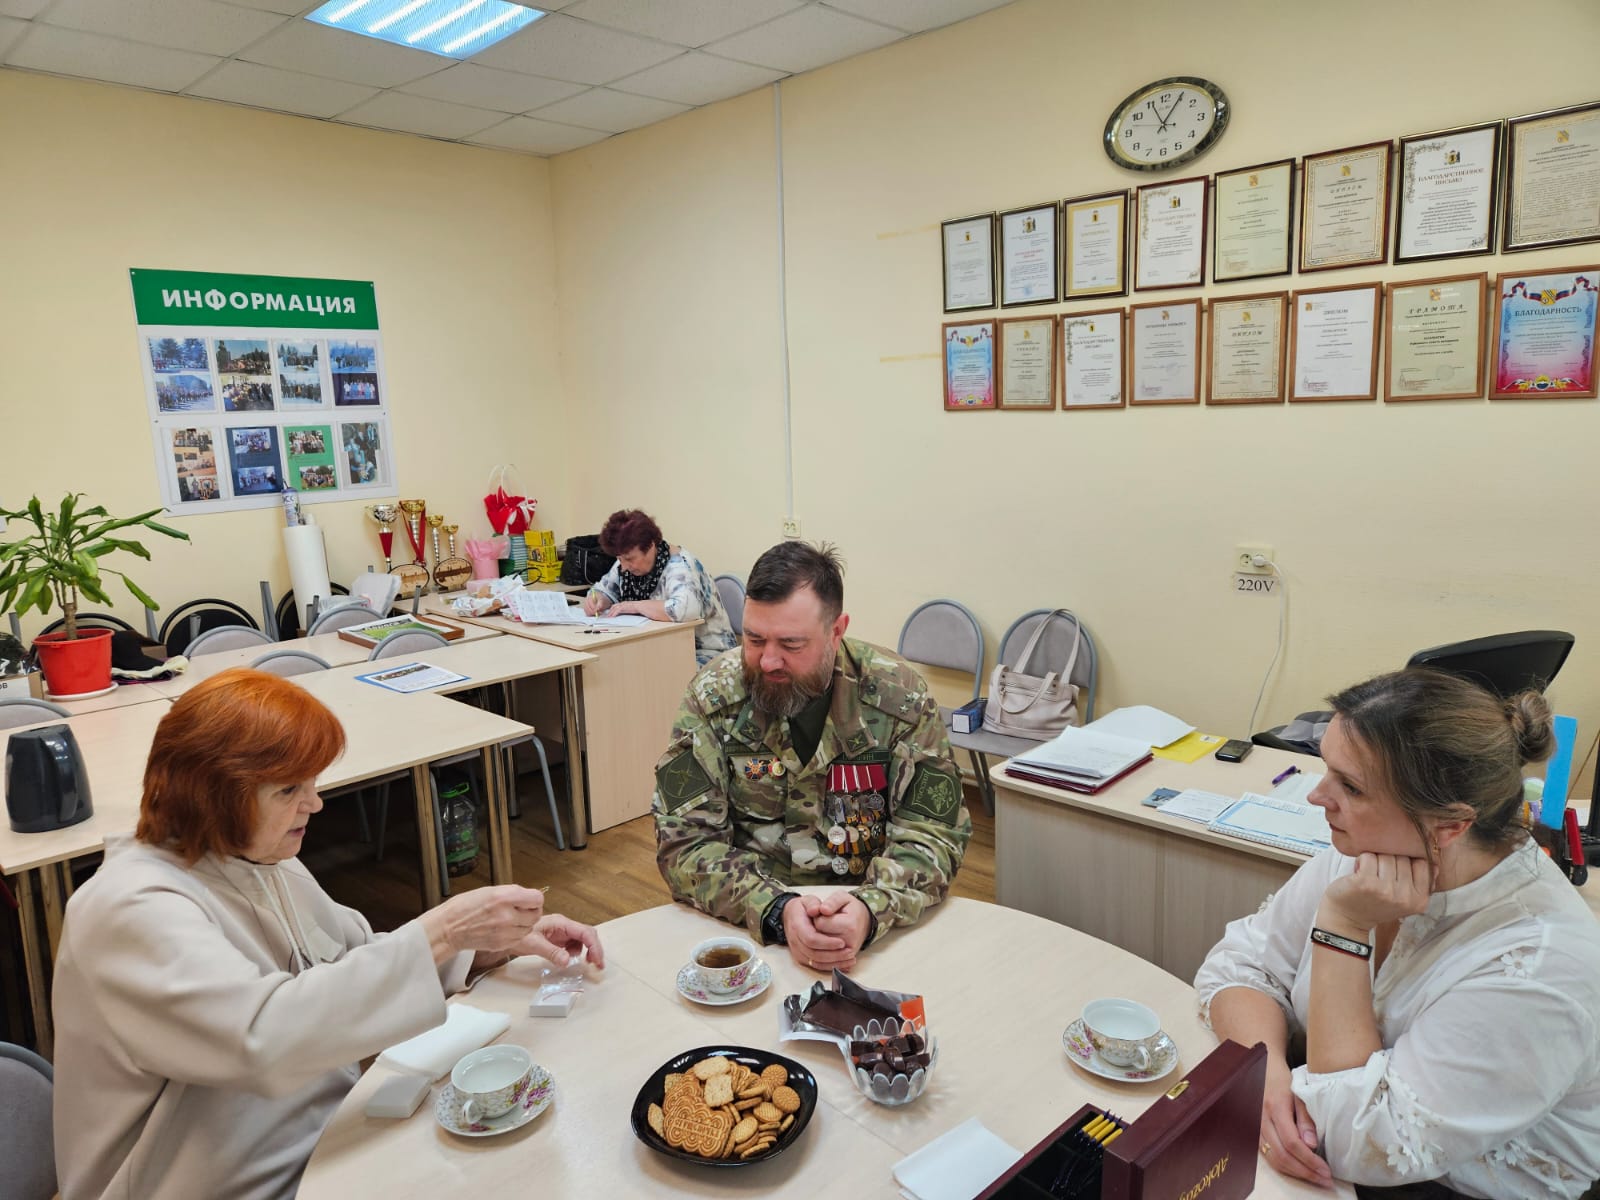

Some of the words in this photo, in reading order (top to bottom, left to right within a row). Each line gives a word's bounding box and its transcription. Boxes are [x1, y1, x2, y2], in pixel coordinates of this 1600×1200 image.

[1160, 94, 1172, 103] 12
[1189, 99, 1197, 108] 2
[1132, 112, 1144, 122] 10
[1197, 112, 1205, 121] 3
[1125, 129, 1133, 138] 9
[1187, 129, 1195, 138] 4
[1132, 142, 1141, 151] 8
[1174, 142, 1182, 151] 5
[1145, 148, 1153, 157] 7
[1159, 147, 1167, 156] 6
[161, 288, 357, 316] ИНФОРМАЦИЯ
[1514, 306, 1582, 317] БЛАГОДАРНОСТЬ
[1237, 578, 1274, 593] 220V
